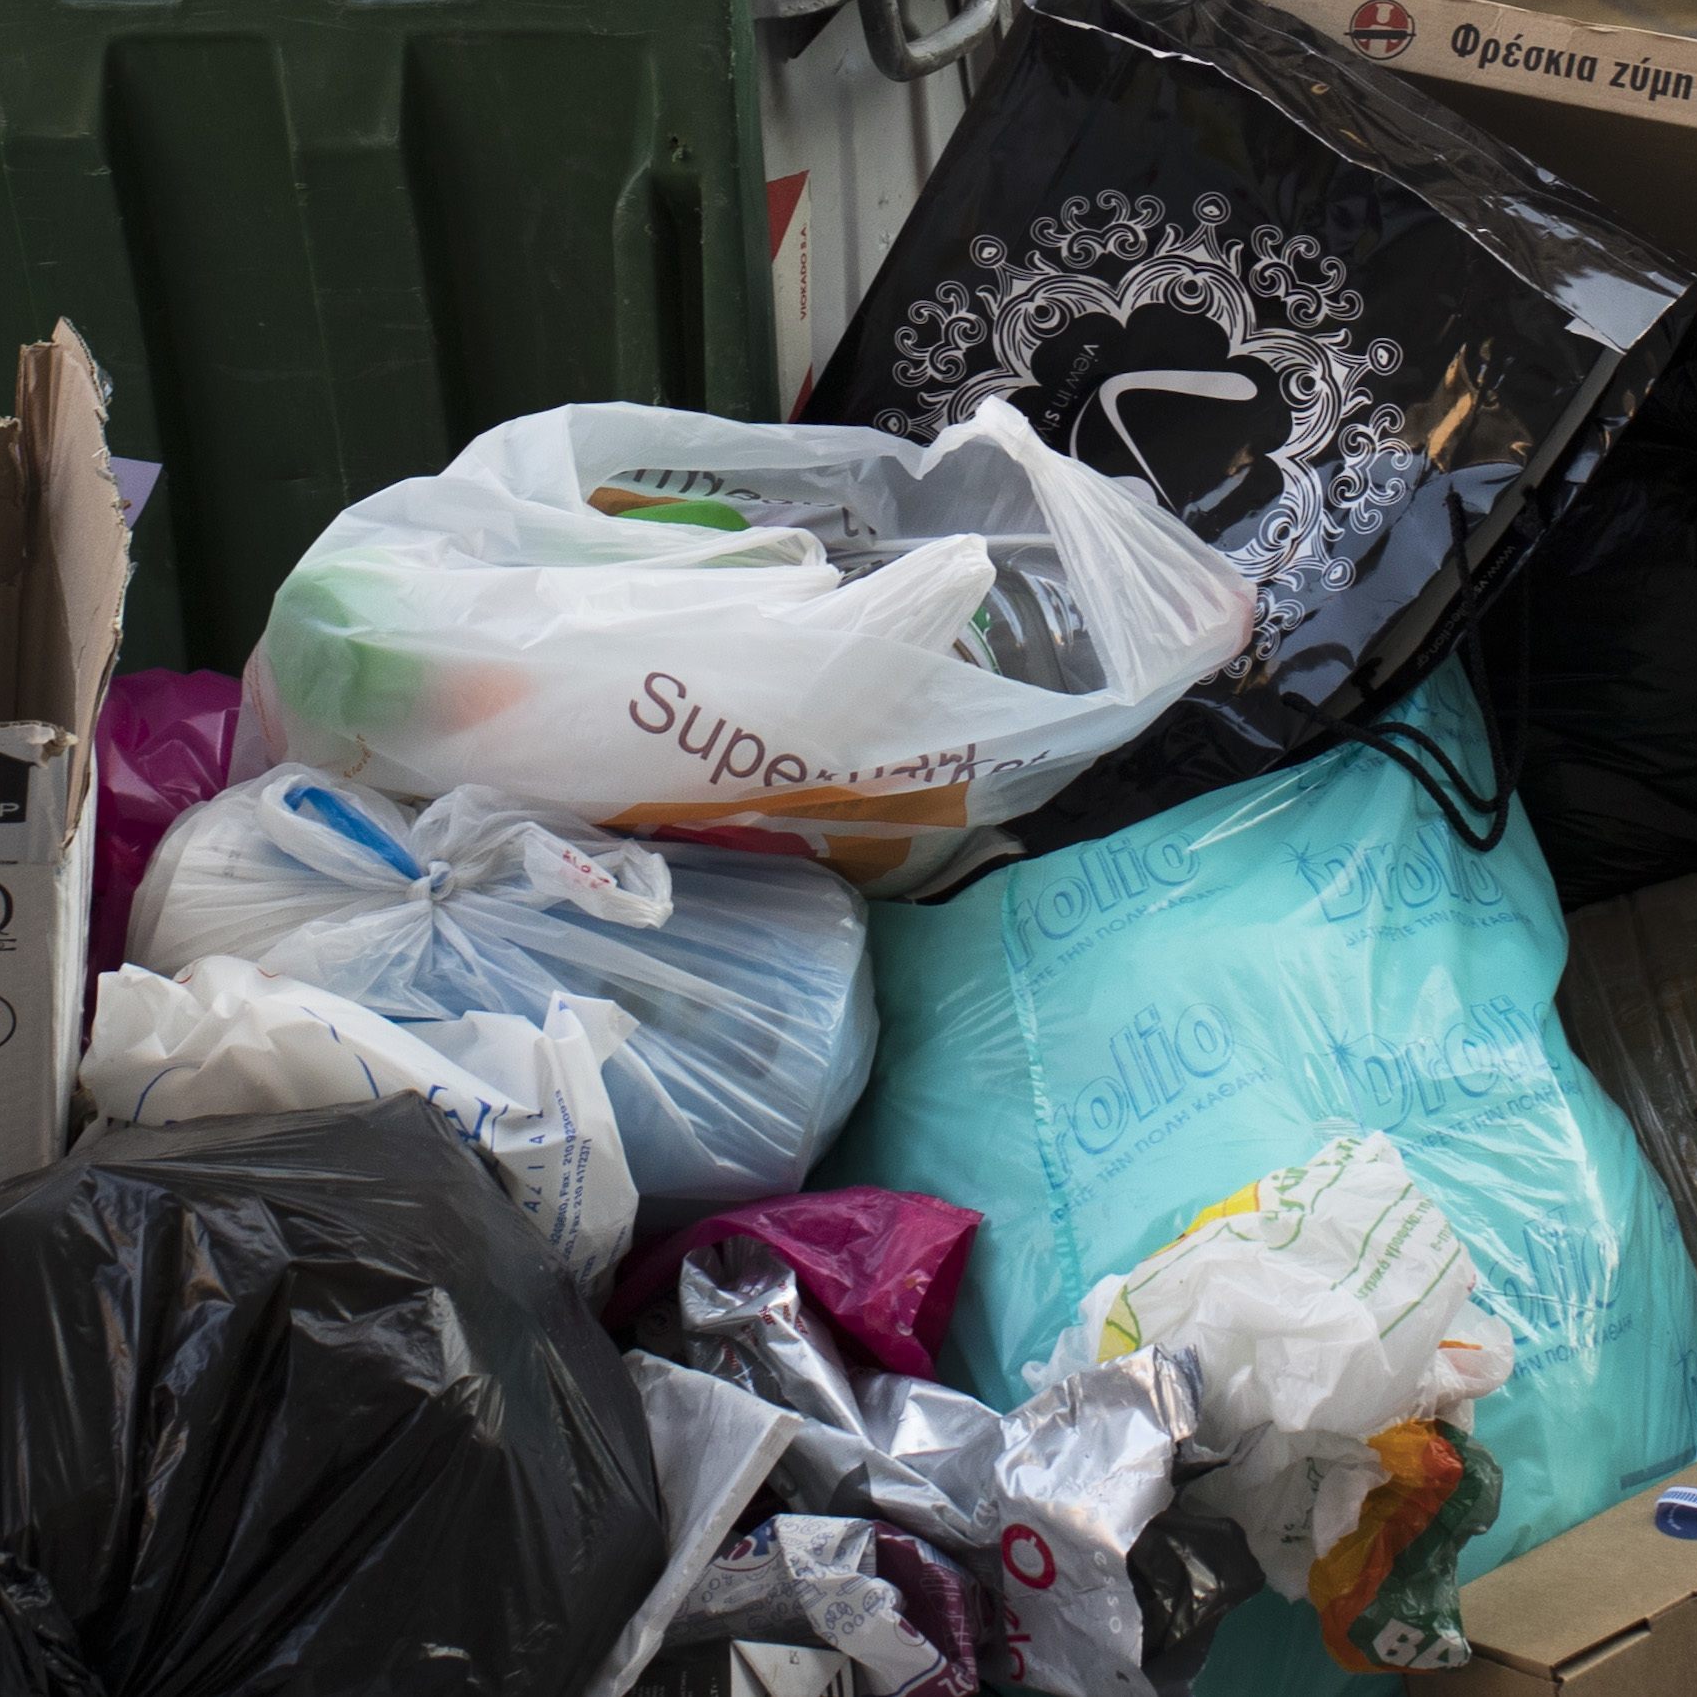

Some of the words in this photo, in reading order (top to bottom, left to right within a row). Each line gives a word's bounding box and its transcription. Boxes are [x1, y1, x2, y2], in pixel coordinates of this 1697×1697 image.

[1449, 21, 1597, 83] Φρέσκια
[1609, 56, 1694, 103] ζύμη
[799, 252, 808, 321] VIOKADO
[1135, 1113, 1193, 1162] ΠΟΛΗ
[1192, 1066, 1273, 1123] ΚΑΘΑΡΗ
[562, 1145, 575, 1168] 210
[573, 1180, 586, 1204] 210
